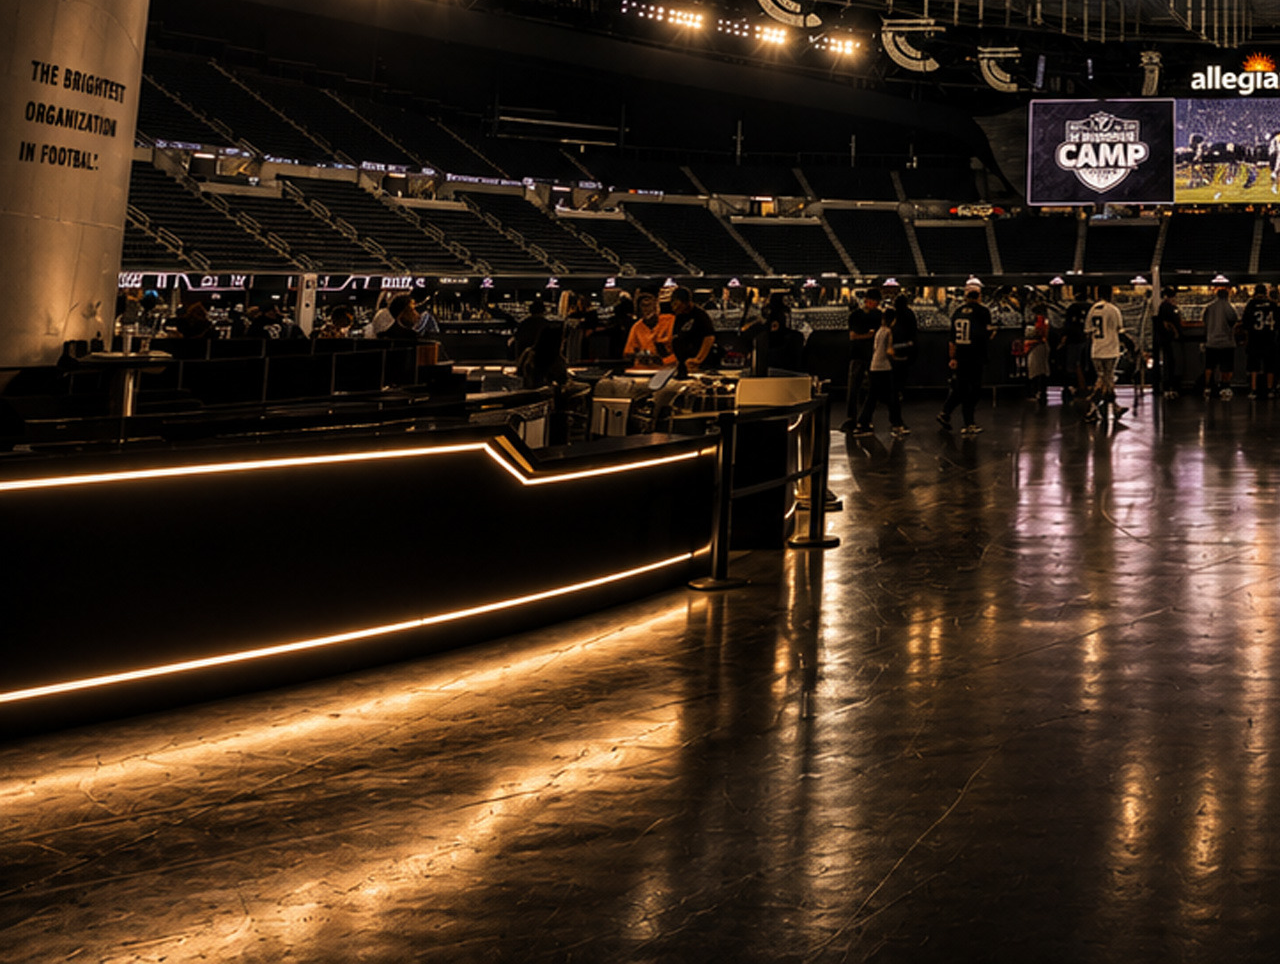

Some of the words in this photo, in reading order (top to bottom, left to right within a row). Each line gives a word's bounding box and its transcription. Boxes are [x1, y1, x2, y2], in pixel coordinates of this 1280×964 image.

[31, 60, 59, 86] THE
[63, 68, 127, 104] BRIGHTEST
[25, 101, 117, 137] ORGANIZATION
[19, 141, 36, 162] IN
[1059, 143, 1146, 167] CAMP
[1253, 311, 1275, 331] 34
